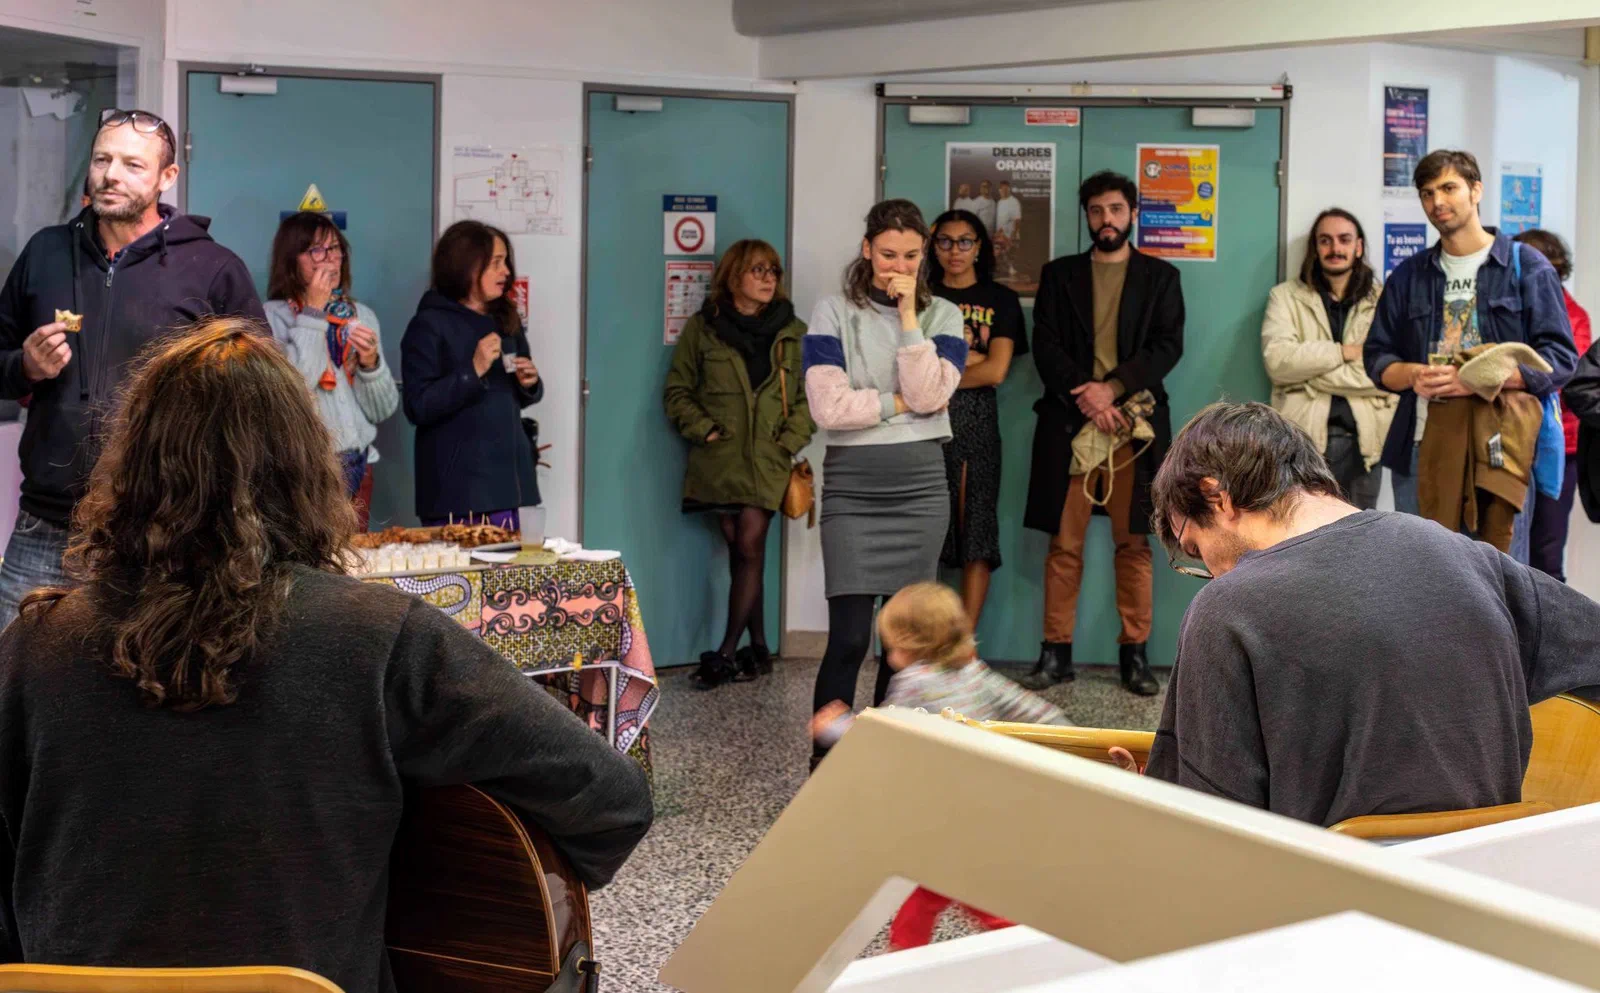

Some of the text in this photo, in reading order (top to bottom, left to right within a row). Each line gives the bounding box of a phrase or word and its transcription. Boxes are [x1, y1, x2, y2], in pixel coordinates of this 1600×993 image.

[992, 147, 1052, 157] DELGRES
[995, 160, 1052, 171] ORANGE
[1445, 278, 1477, 291] TAN
